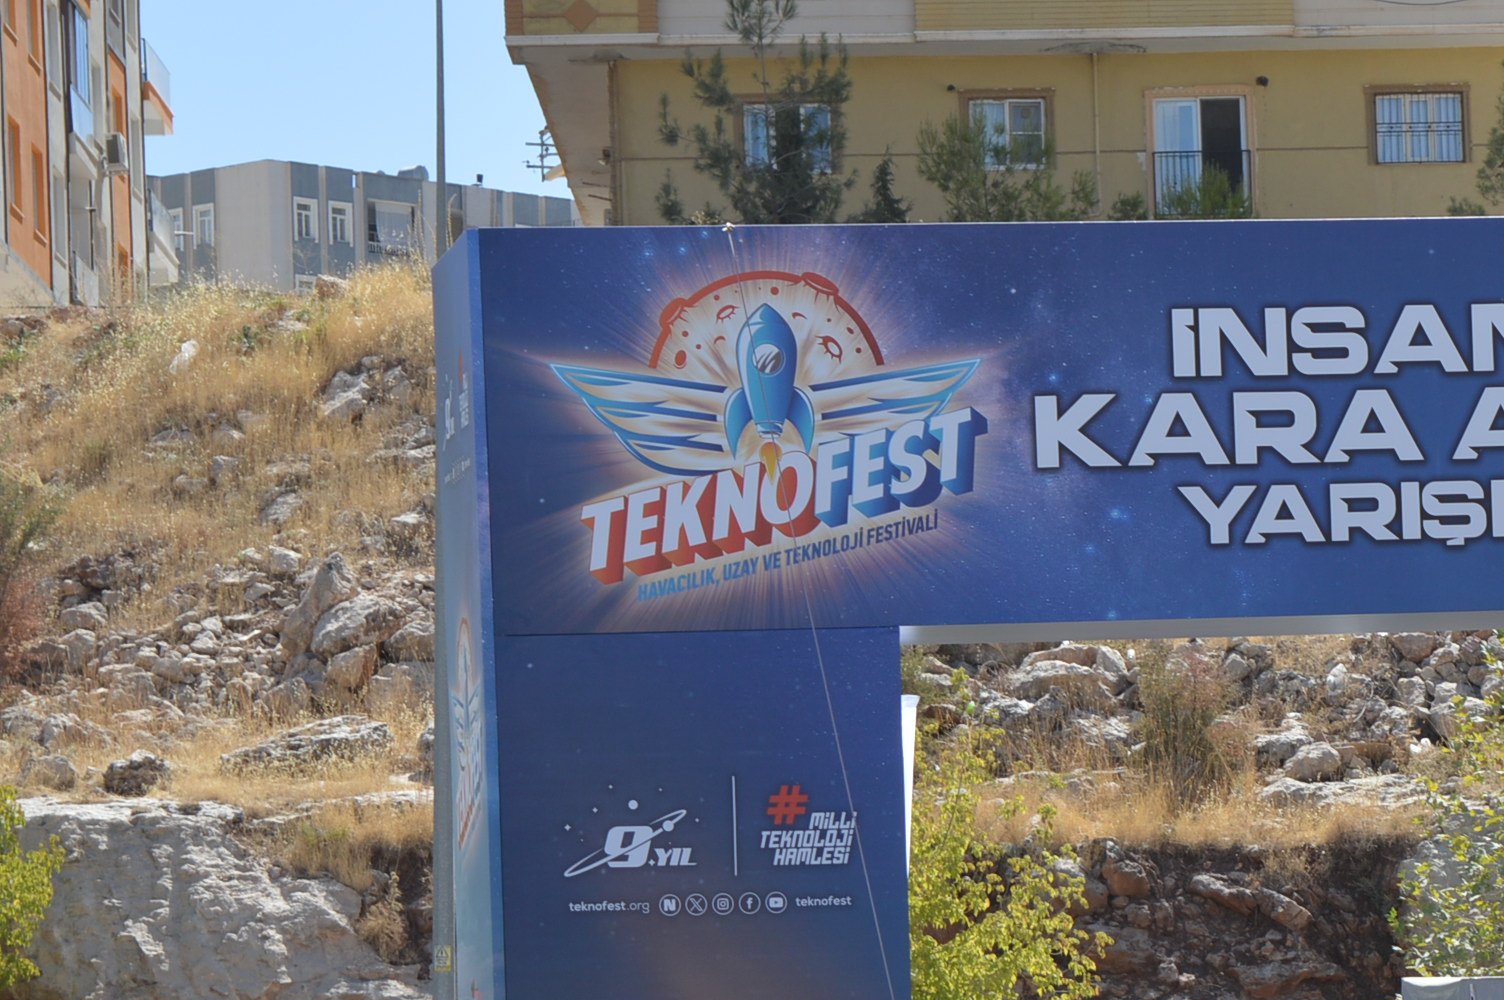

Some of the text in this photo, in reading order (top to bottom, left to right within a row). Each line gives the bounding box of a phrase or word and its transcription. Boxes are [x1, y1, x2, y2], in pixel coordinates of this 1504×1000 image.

[1034, 389, 1422, 468] KARA
[581, 406, 988, 586] TEKNOFEST
[723, 557, 760, 581] UZAY
[763, 553, 781, 572] VE
[784, 529, 863, 566] TEKNOLOJİ
[866, 508, 938, 547] FESTİVALİ
[569, 900, 650, 914] teknofest.org
[795, 895, 852, 907] teknofest
